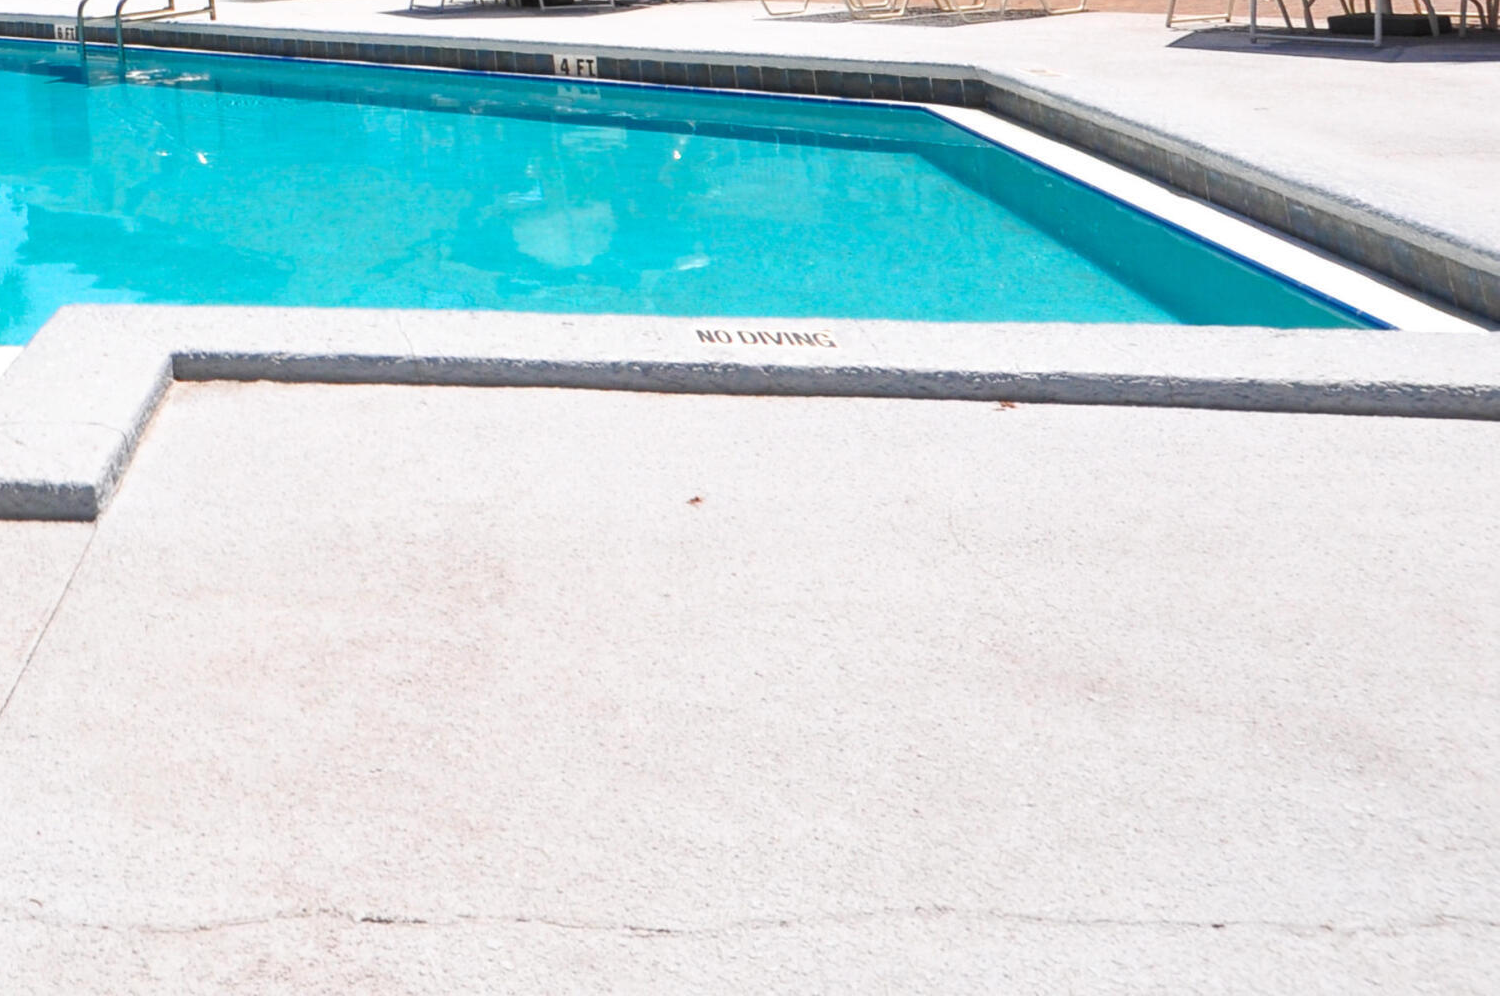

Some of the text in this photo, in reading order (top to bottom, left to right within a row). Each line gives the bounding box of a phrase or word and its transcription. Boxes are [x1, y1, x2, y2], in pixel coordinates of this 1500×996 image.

[560, 57, 570, 76] 4
[695, 329, 838, 348] NO DIVING
